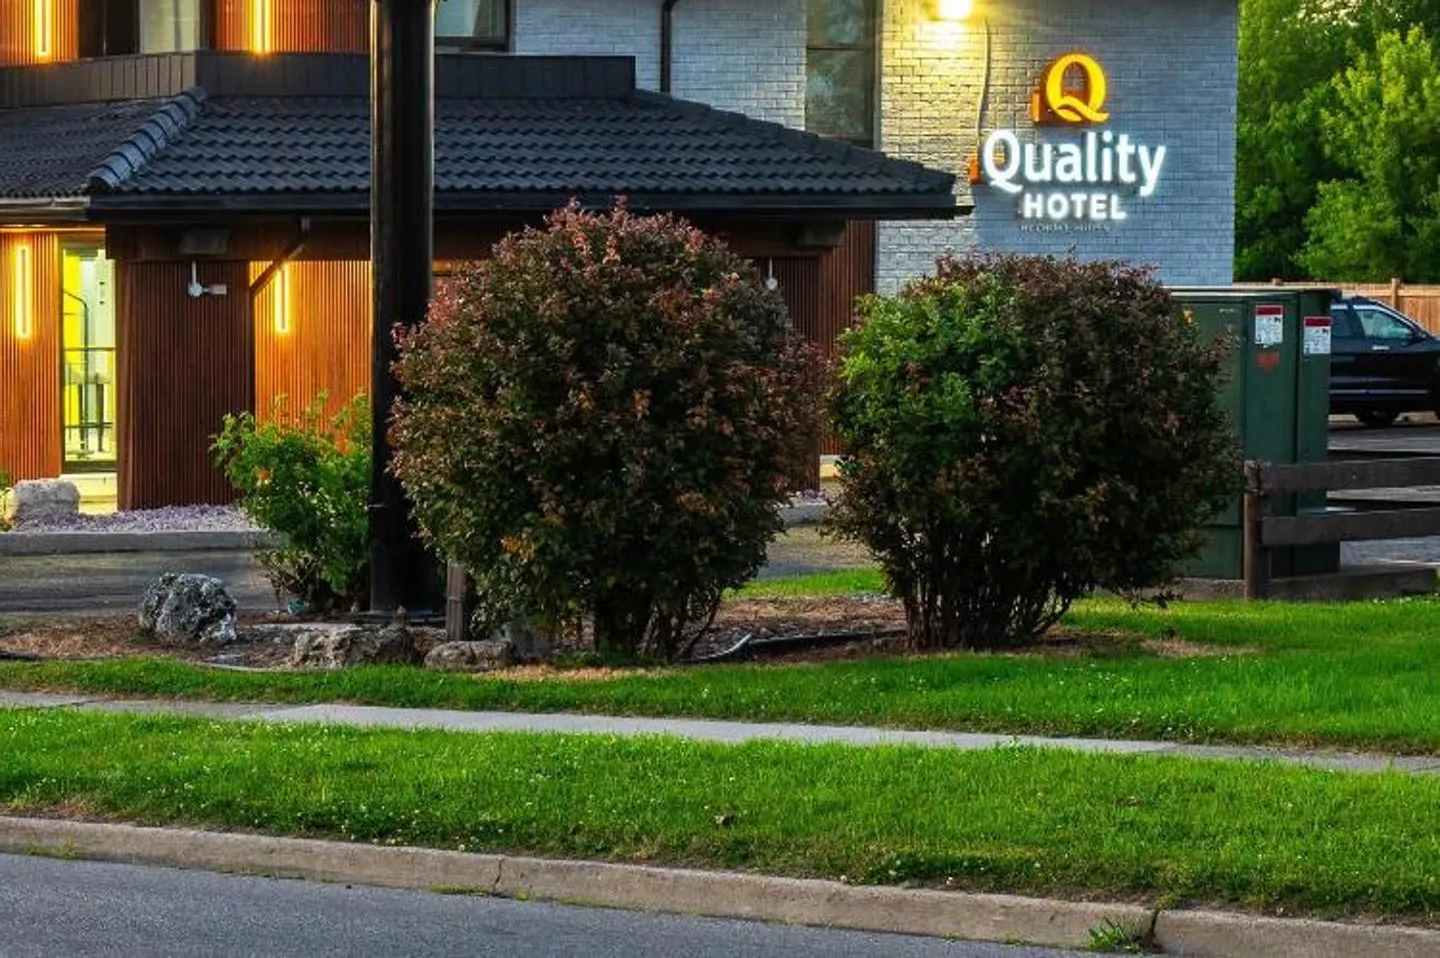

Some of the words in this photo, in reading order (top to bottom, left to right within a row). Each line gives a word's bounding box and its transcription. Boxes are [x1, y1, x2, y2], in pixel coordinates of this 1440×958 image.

[1046, 53, 1110, 123] Q
[982, 129, 1166, 197] Quality
[1023, 193, 1128, 220] HOTEL
